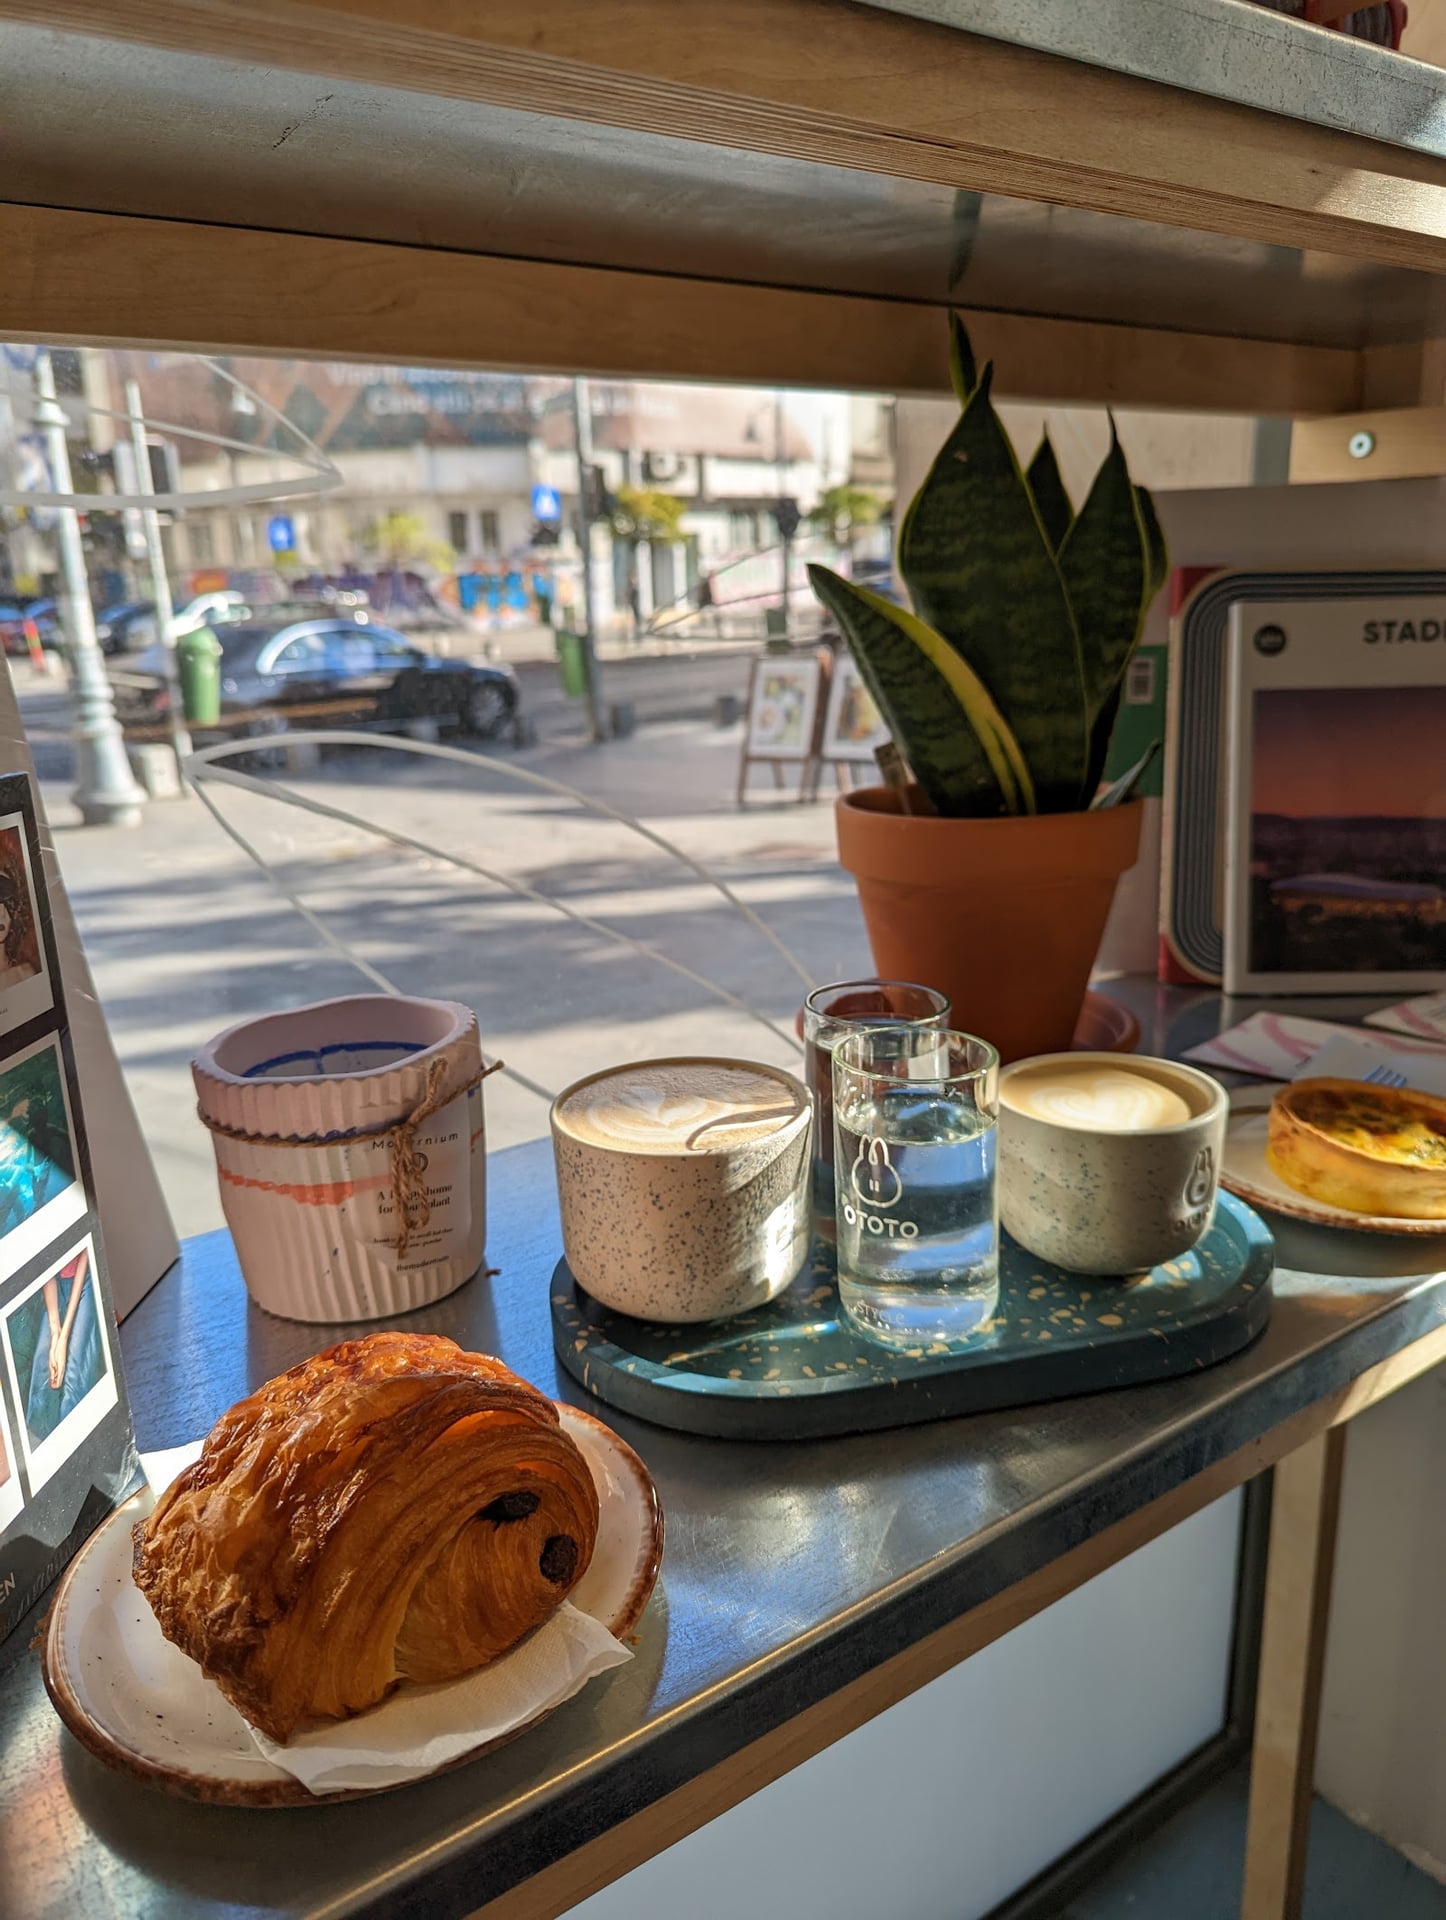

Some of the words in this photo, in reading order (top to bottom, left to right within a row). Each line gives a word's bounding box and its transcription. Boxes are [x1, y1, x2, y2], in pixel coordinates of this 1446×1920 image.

[372, 1132, 459, 1150] Mornium
[378, 1203, 395, 1215] for
[844, 1204, 919, 1240] OTOTO
